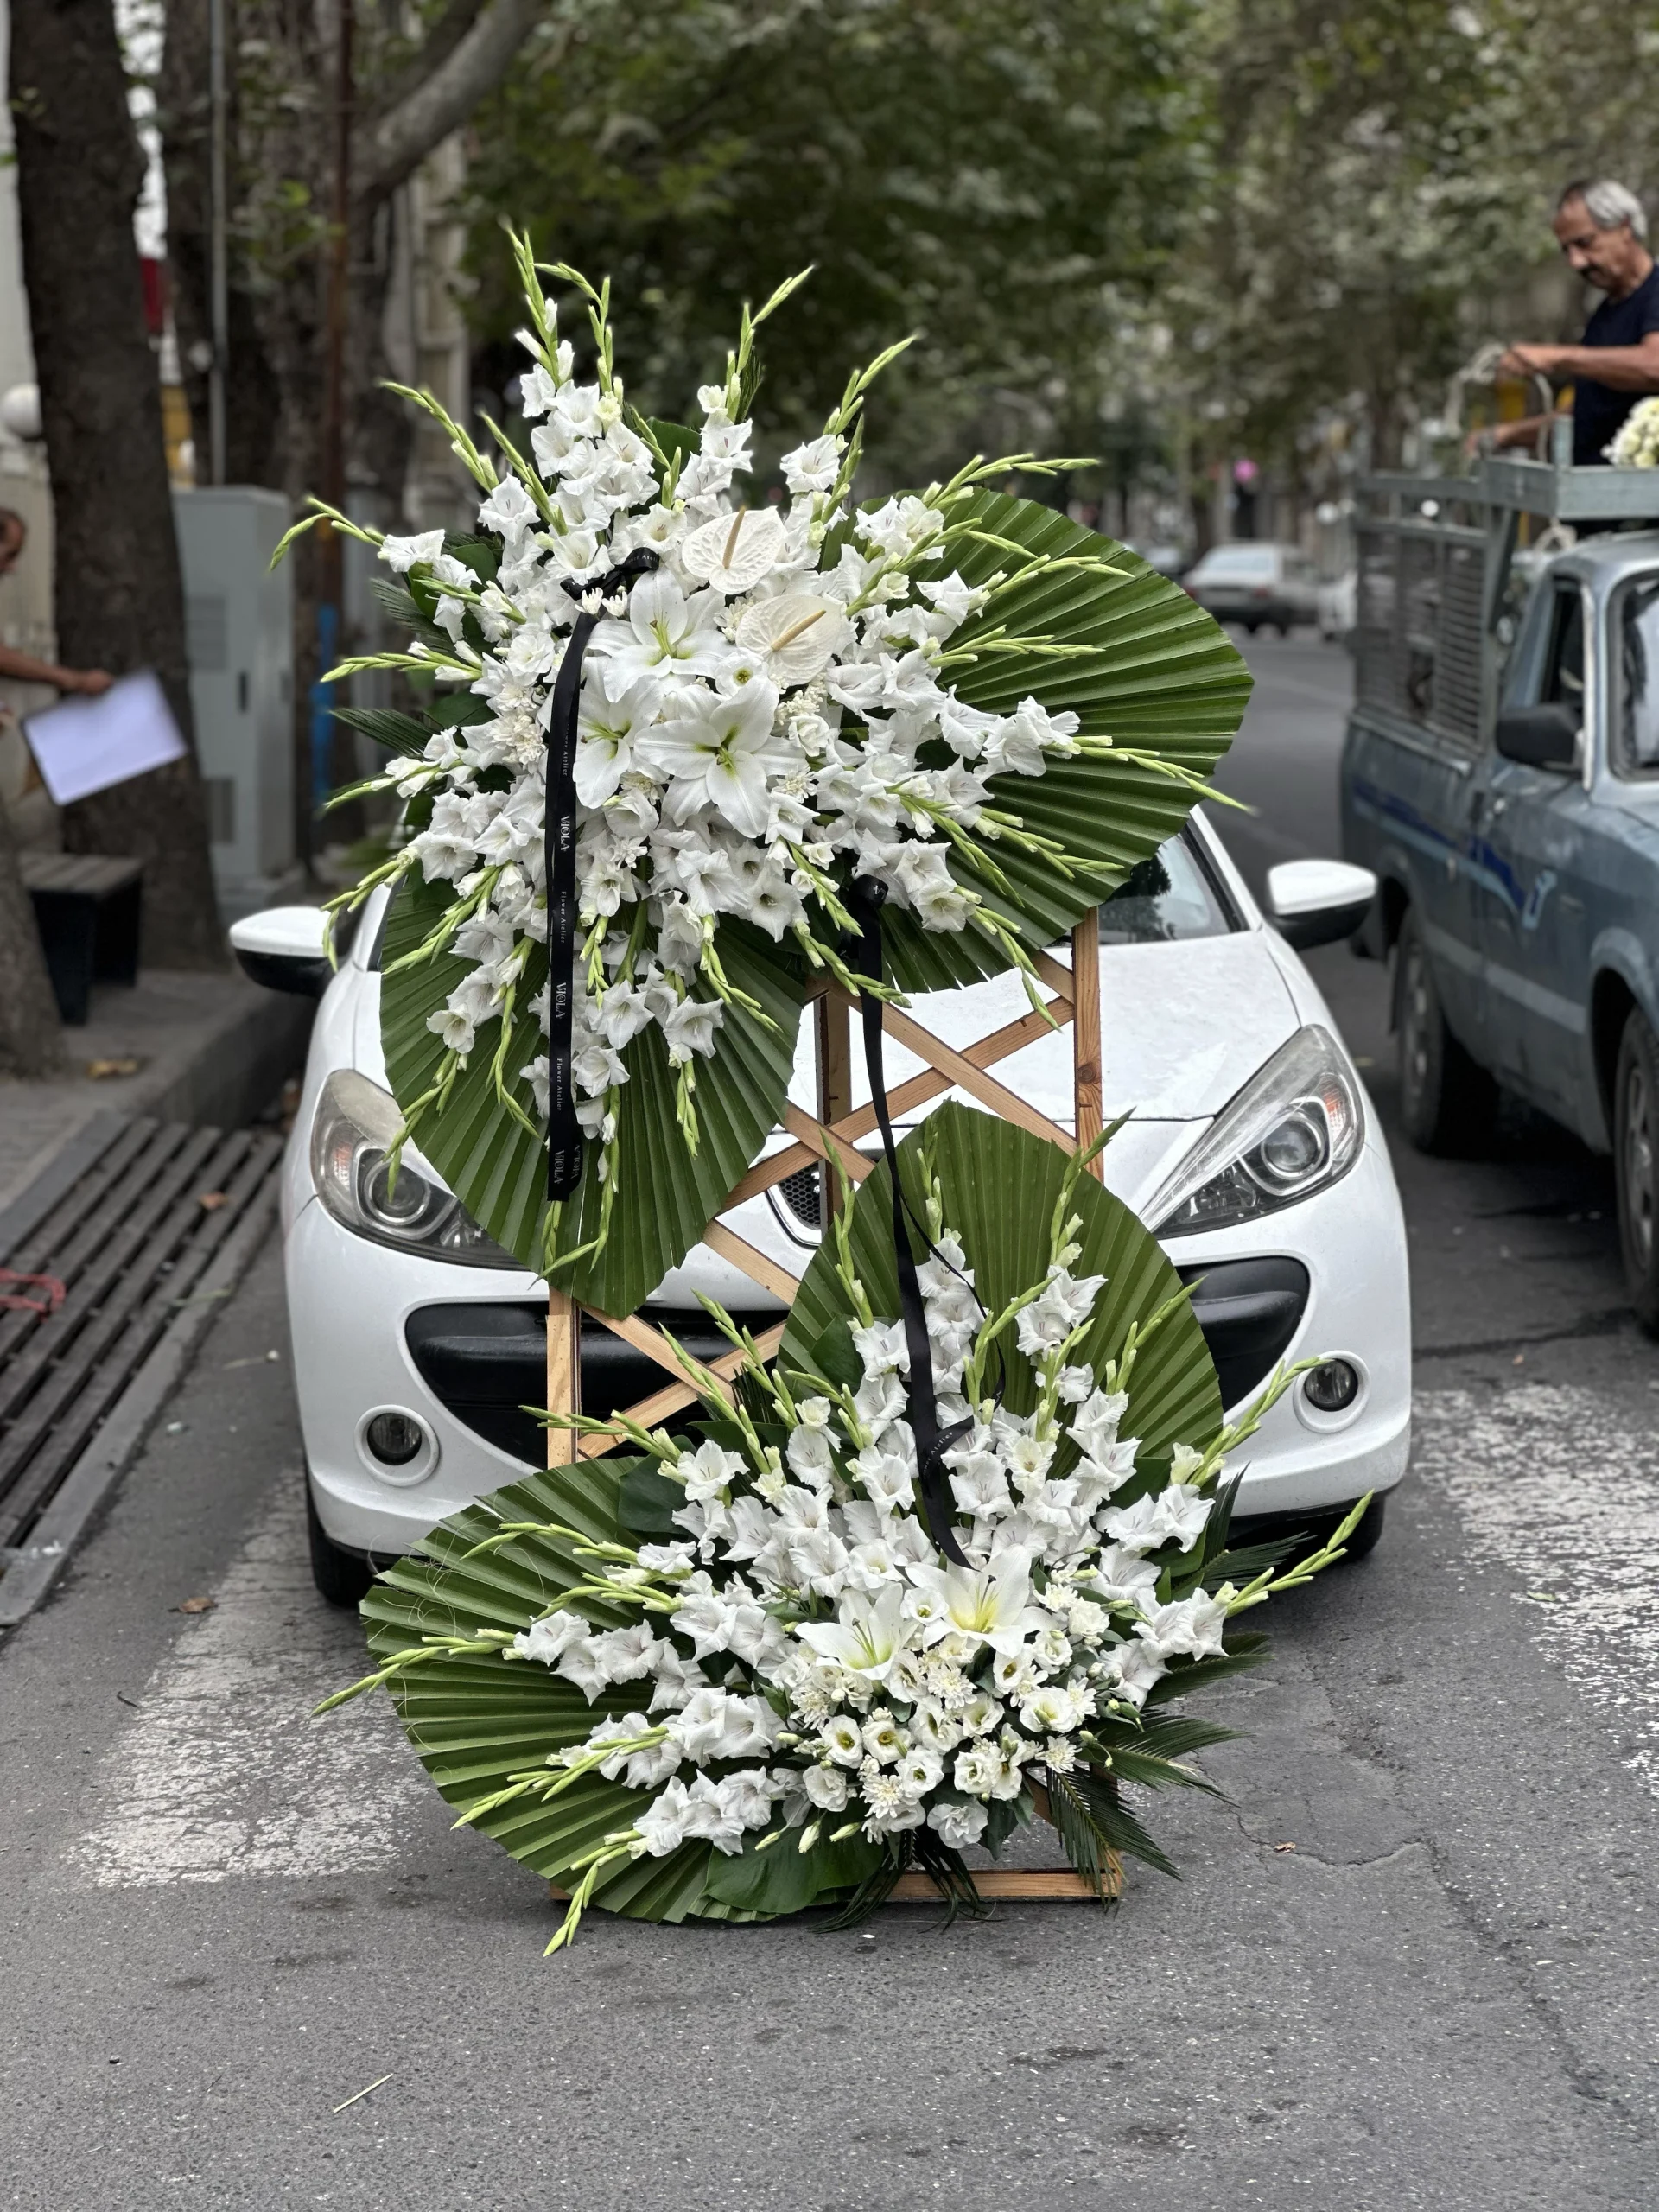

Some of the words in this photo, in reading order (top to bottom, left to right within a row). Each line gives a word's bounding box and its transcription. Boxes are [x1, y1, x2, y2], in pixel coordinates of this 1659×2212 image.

[560, 815, 570, 852] VIOLA
[556, 982, 567, 1020] VIOLA
[554, 1149, 565, 1185] VIOLA
[931, 1432, 953, 1455] Atelier
